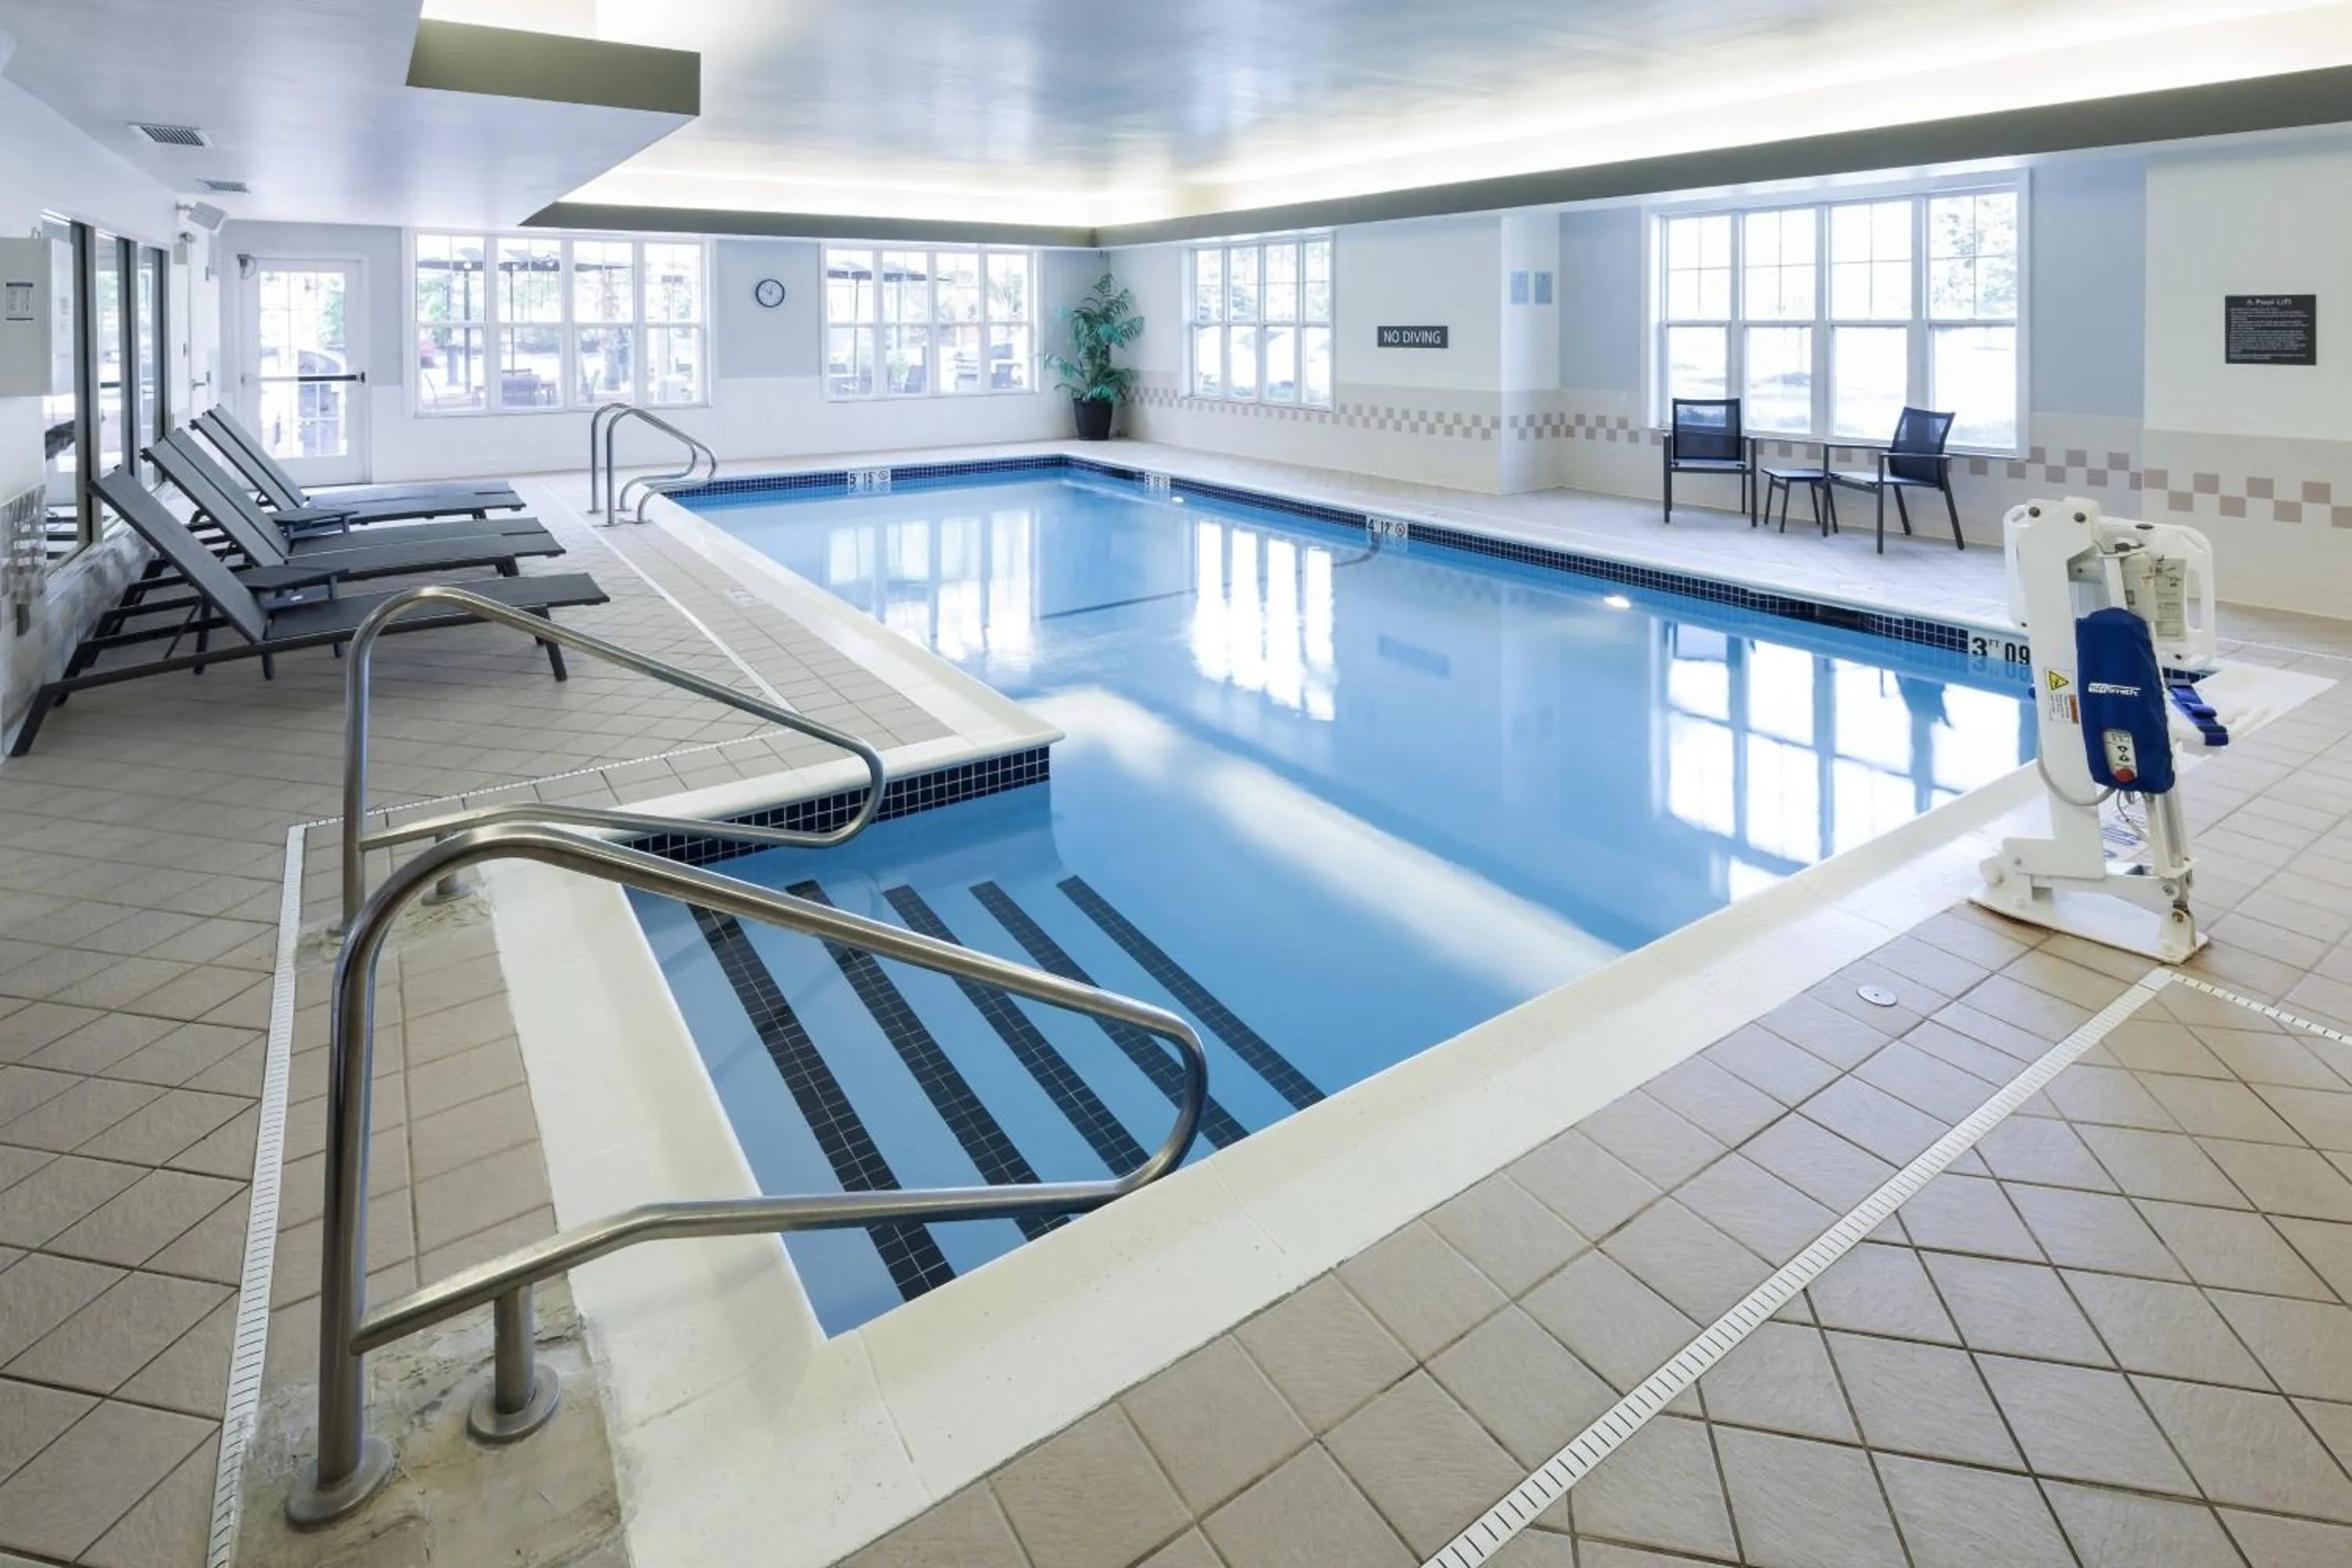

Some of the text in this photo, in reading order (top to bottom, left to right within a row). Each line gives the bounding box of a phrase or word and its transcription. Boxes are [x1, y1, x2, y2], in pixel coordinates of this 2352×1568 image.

[1383, 329, 1441, 345] NO DIVING
[1972, 637, 1987, 656] 3
